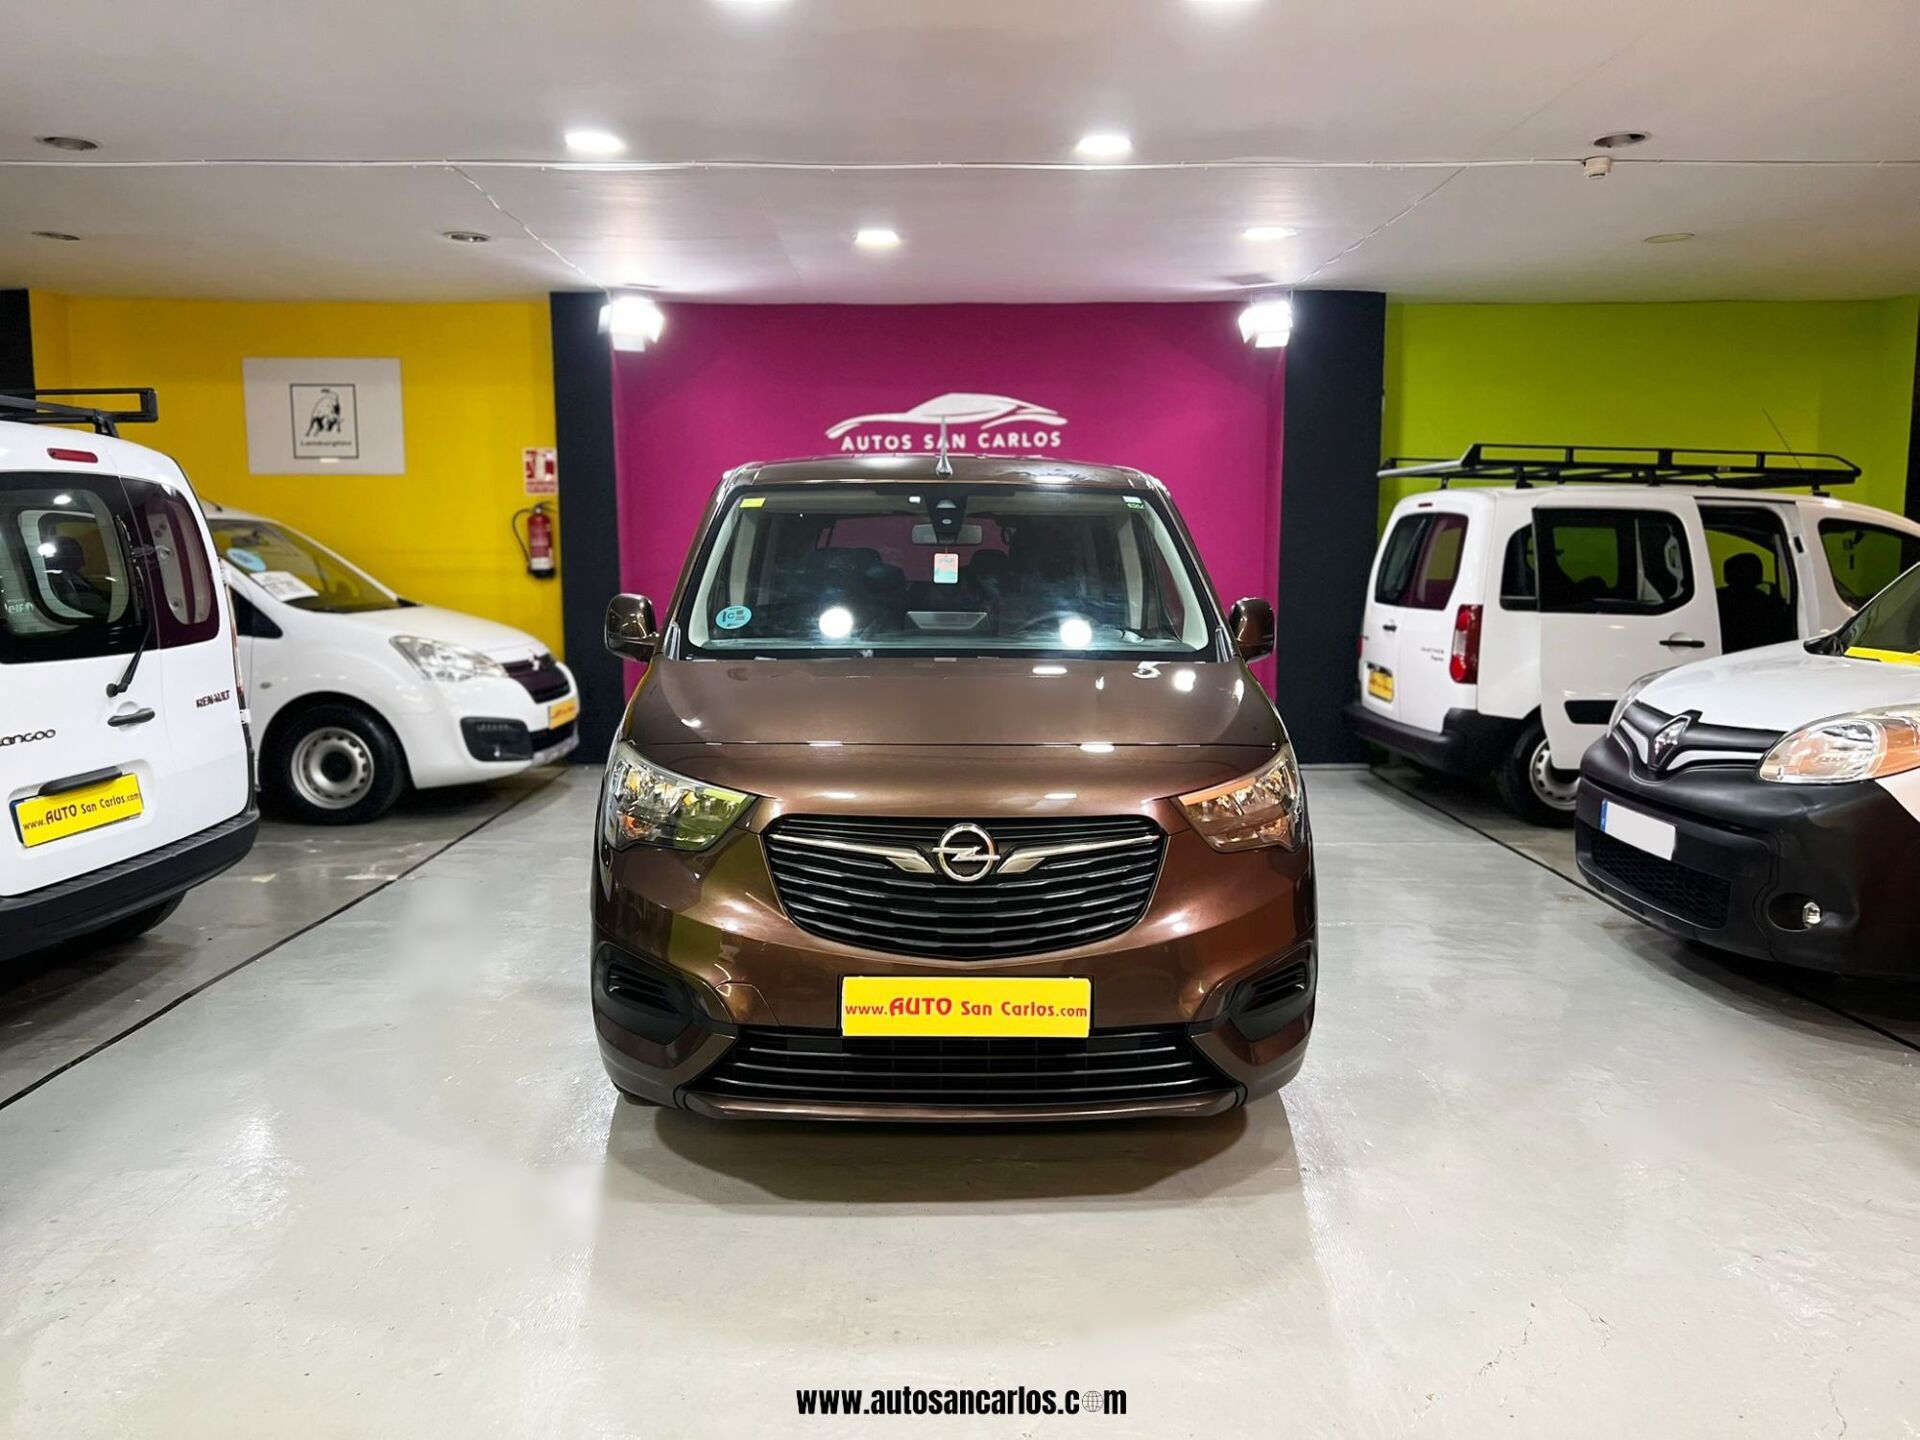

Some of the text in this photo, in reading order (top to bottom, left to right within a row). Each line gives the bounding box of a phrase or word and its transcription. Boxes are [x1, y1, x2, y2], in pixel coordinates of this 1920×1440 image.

[841, 431, 1062, 452] AUTOS SAN CARLOS
[81, 803, 97, 814] San
[845, 998, 1088, 1017] www.AUTO San Carlos.com
